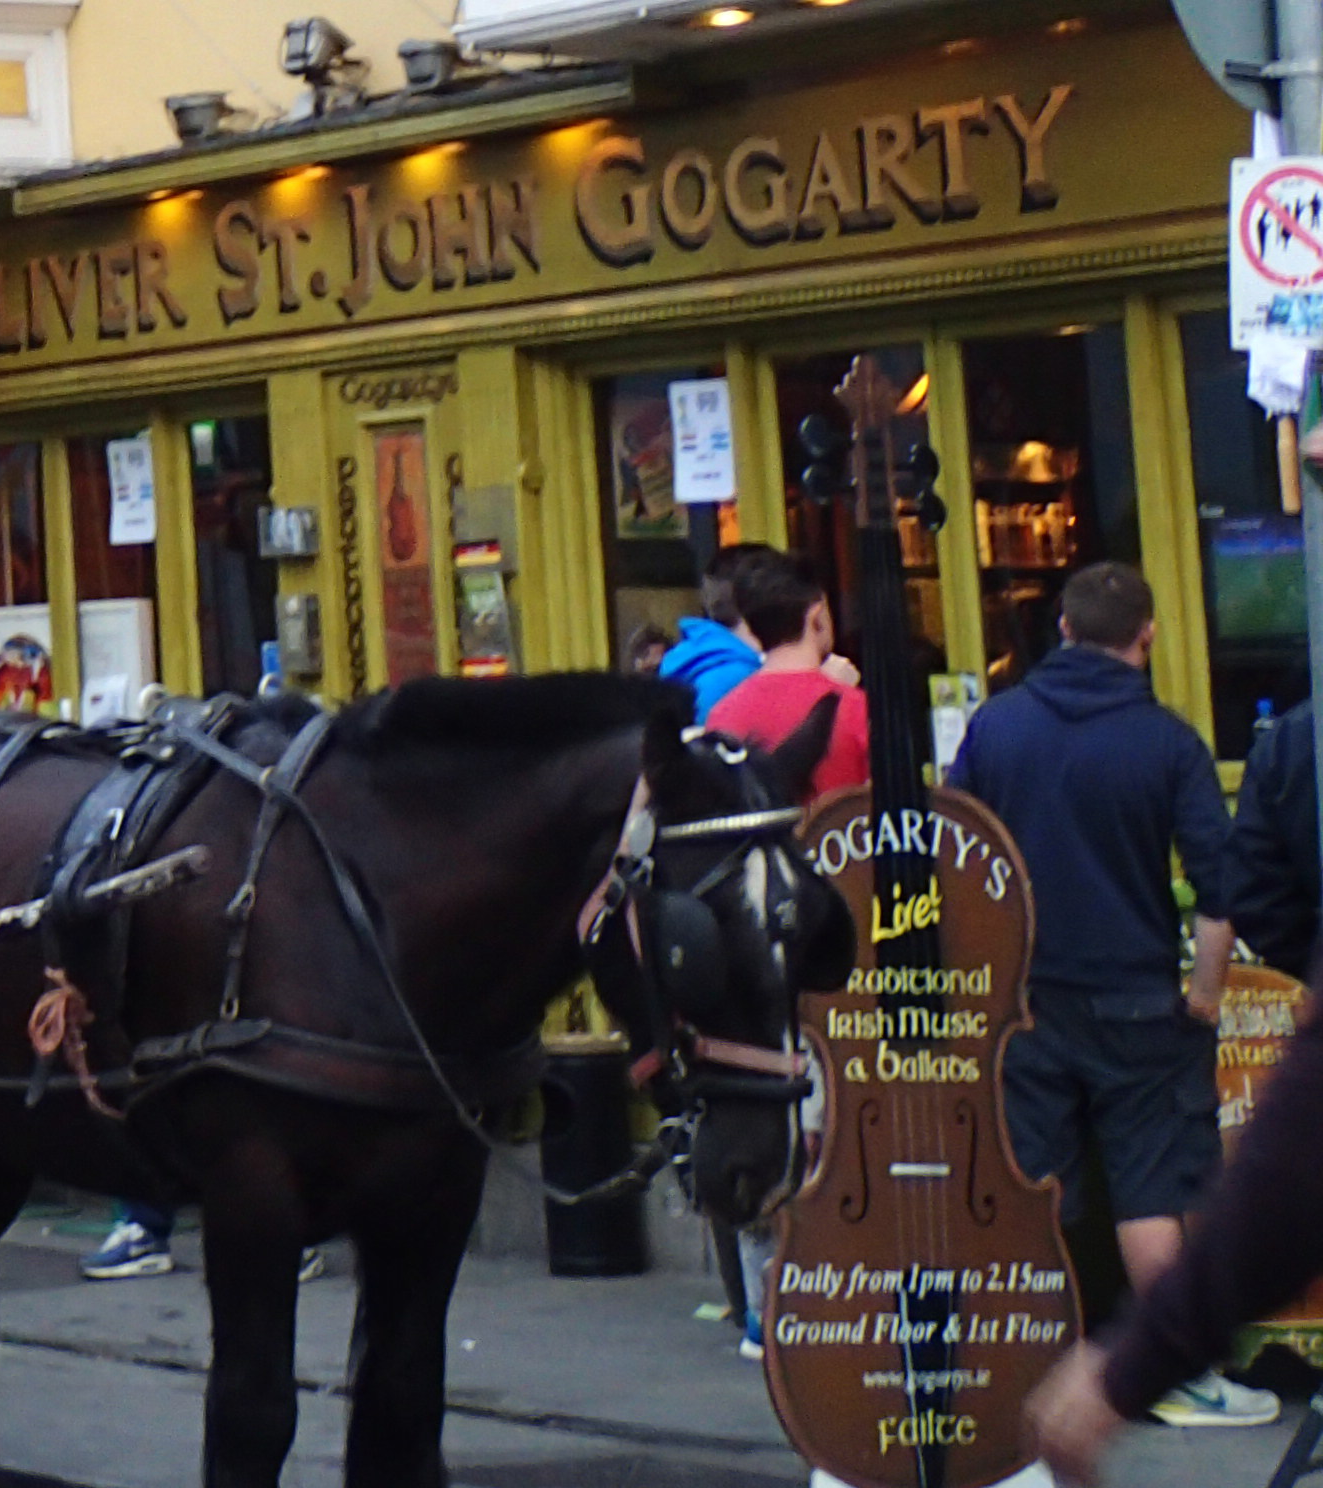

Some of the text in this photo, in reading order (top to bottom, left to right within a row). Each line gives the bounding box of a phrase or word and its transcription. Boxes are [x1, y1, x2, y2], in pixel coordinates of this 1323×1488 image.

[337, 178, 541, 318] JOHN
[575, 83, 1077, 269] GOGARTY
[845, 1262, 904, 1301] from
[960, 1267, 984, 1292] to
[776, 1312, 867, 1345] Ground
[1004, 1311, 1068, 1344] Floor
